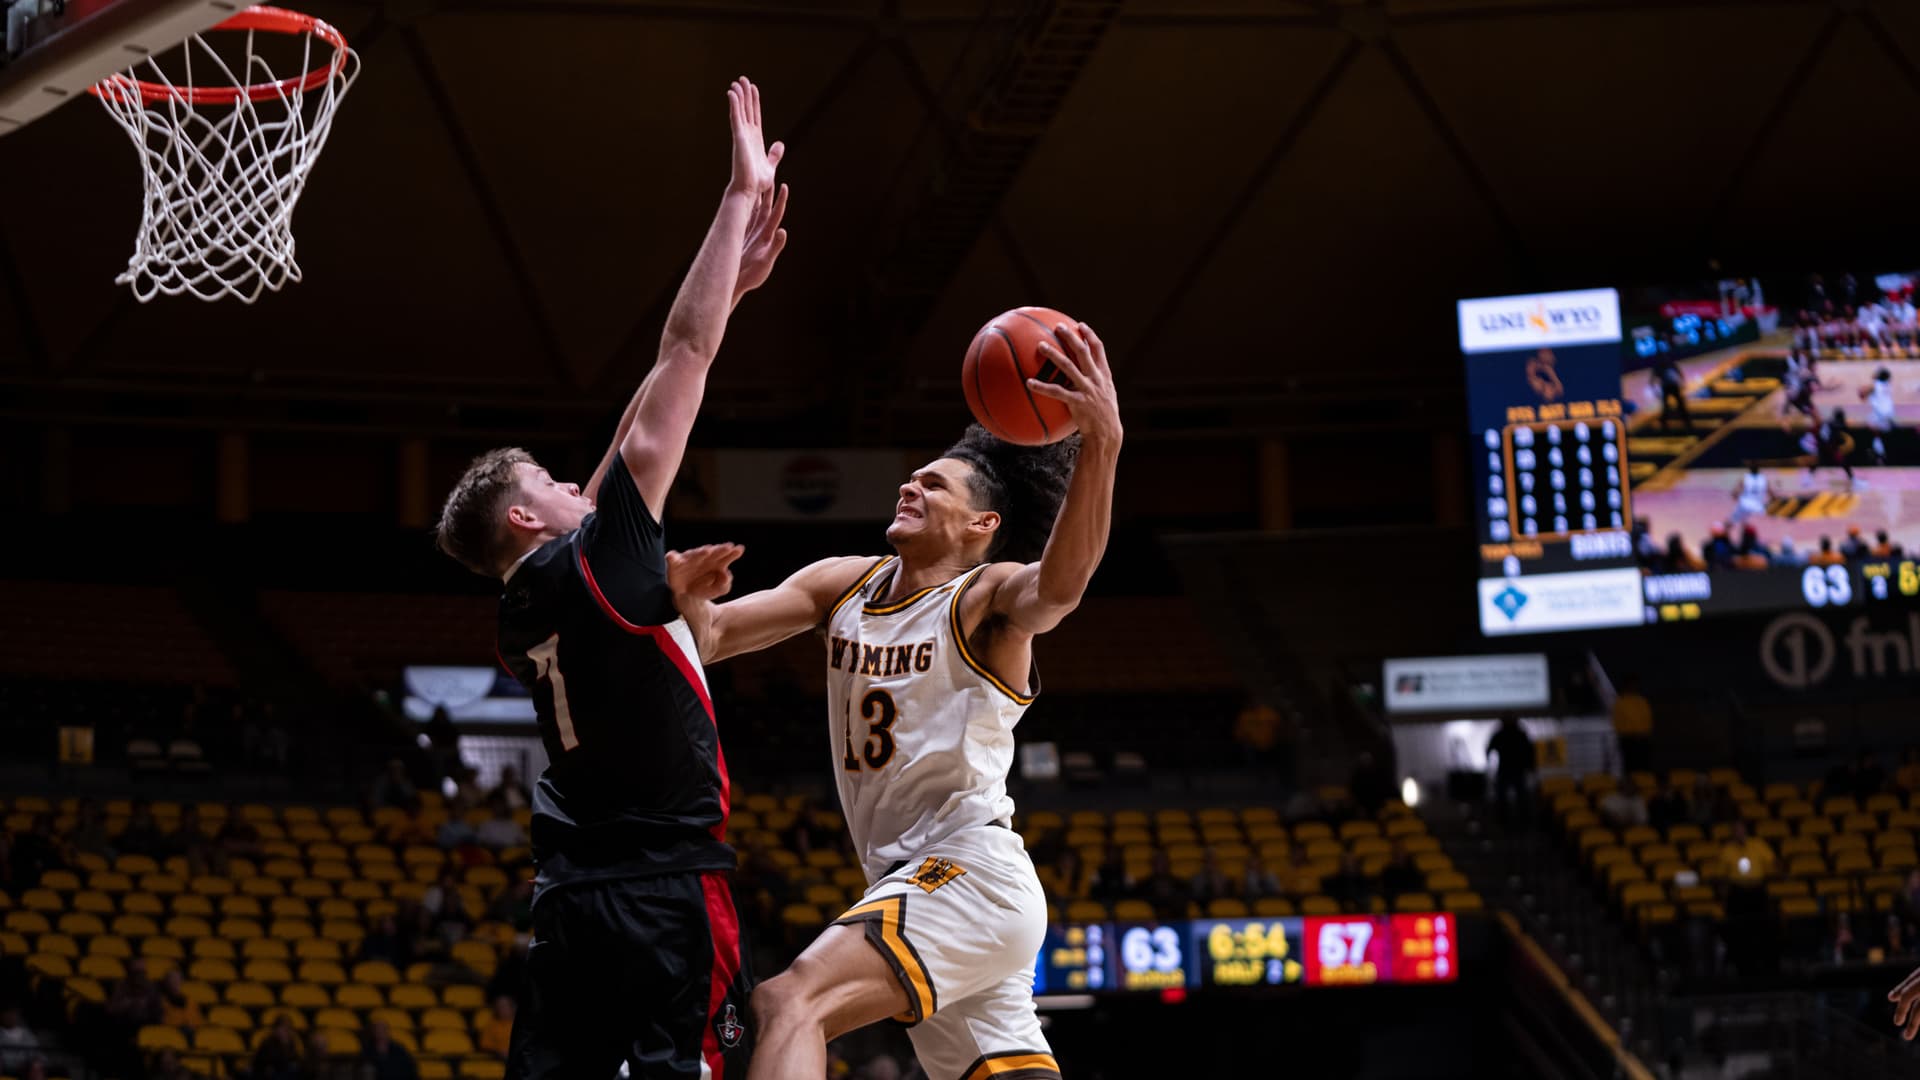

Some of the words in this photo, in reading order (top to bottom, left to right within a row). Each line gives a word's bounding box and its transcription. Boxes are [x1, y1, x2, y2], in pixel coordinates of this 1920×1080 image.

[1802, 564, 1853, 608] 63
[526, 632, 580, 753] 7
[844, 688, 898, 772] 13
[1123, 926, 1181, 973] 63
[1209, 922, 1288, 960] 6:54
